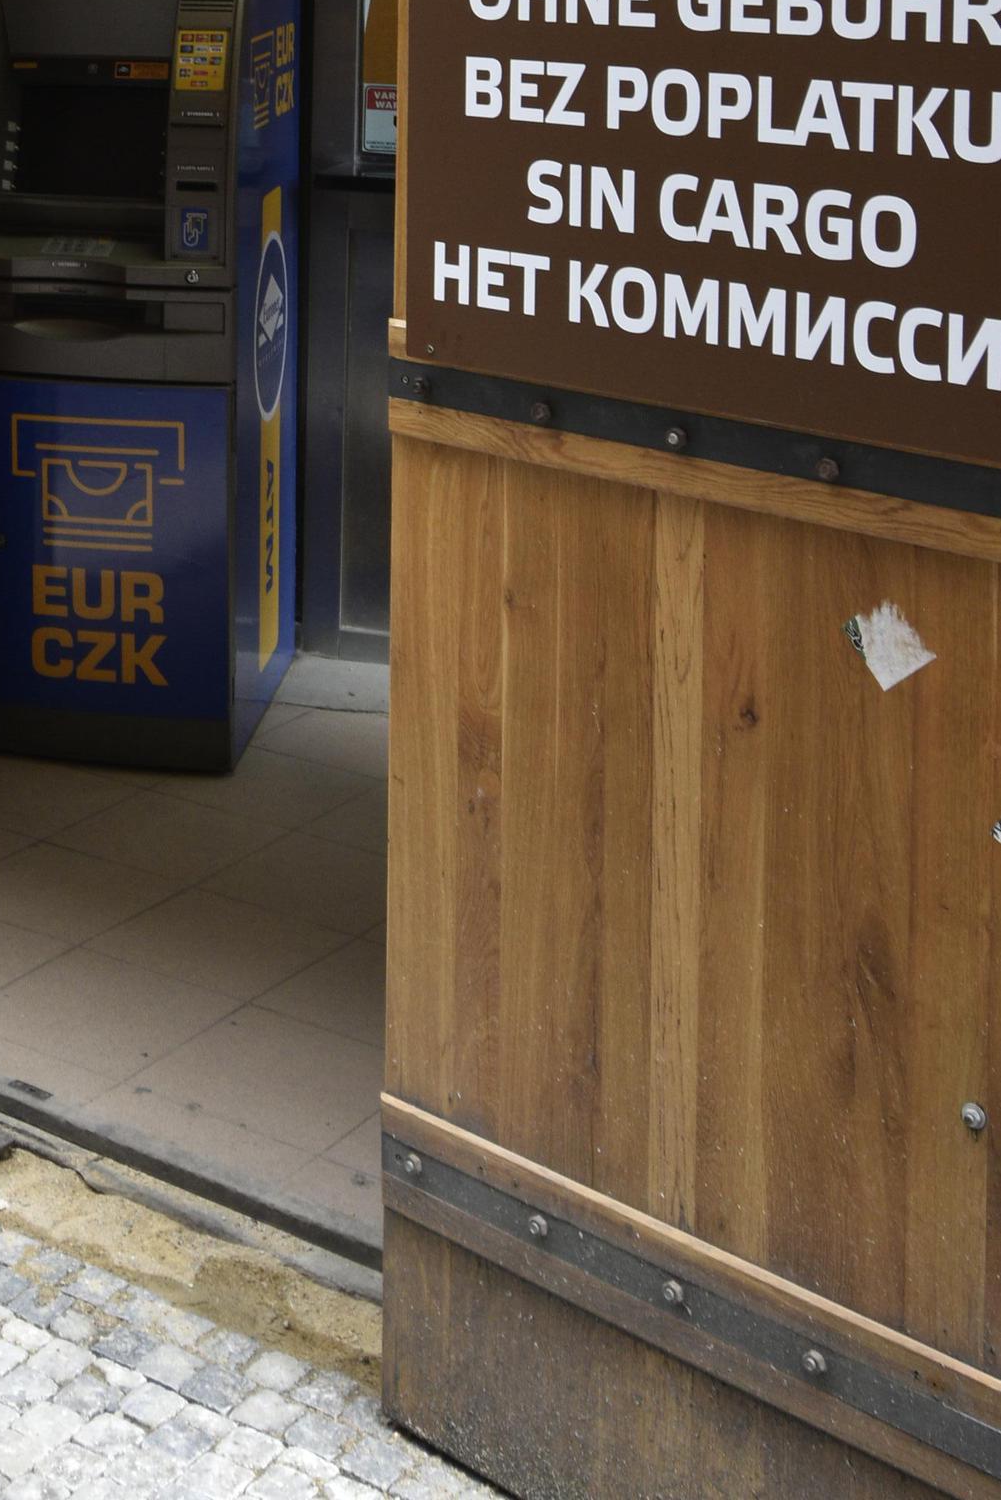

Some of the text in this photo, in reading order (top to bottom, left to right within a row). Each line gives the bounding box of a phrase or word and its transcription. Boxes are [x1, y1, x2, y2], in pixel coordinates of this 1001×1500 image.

[465, 56, 1001, 163] BEZ POPLATKU
[527, 160, 916, 267] SIN CARGO
[434, 241, 1001, 392] НЕТ КОММИССИ
[261, 458, 275, 596] ATM
[31, 564, 164, 625] EUR
[30, 626, 169, 687] CZK
